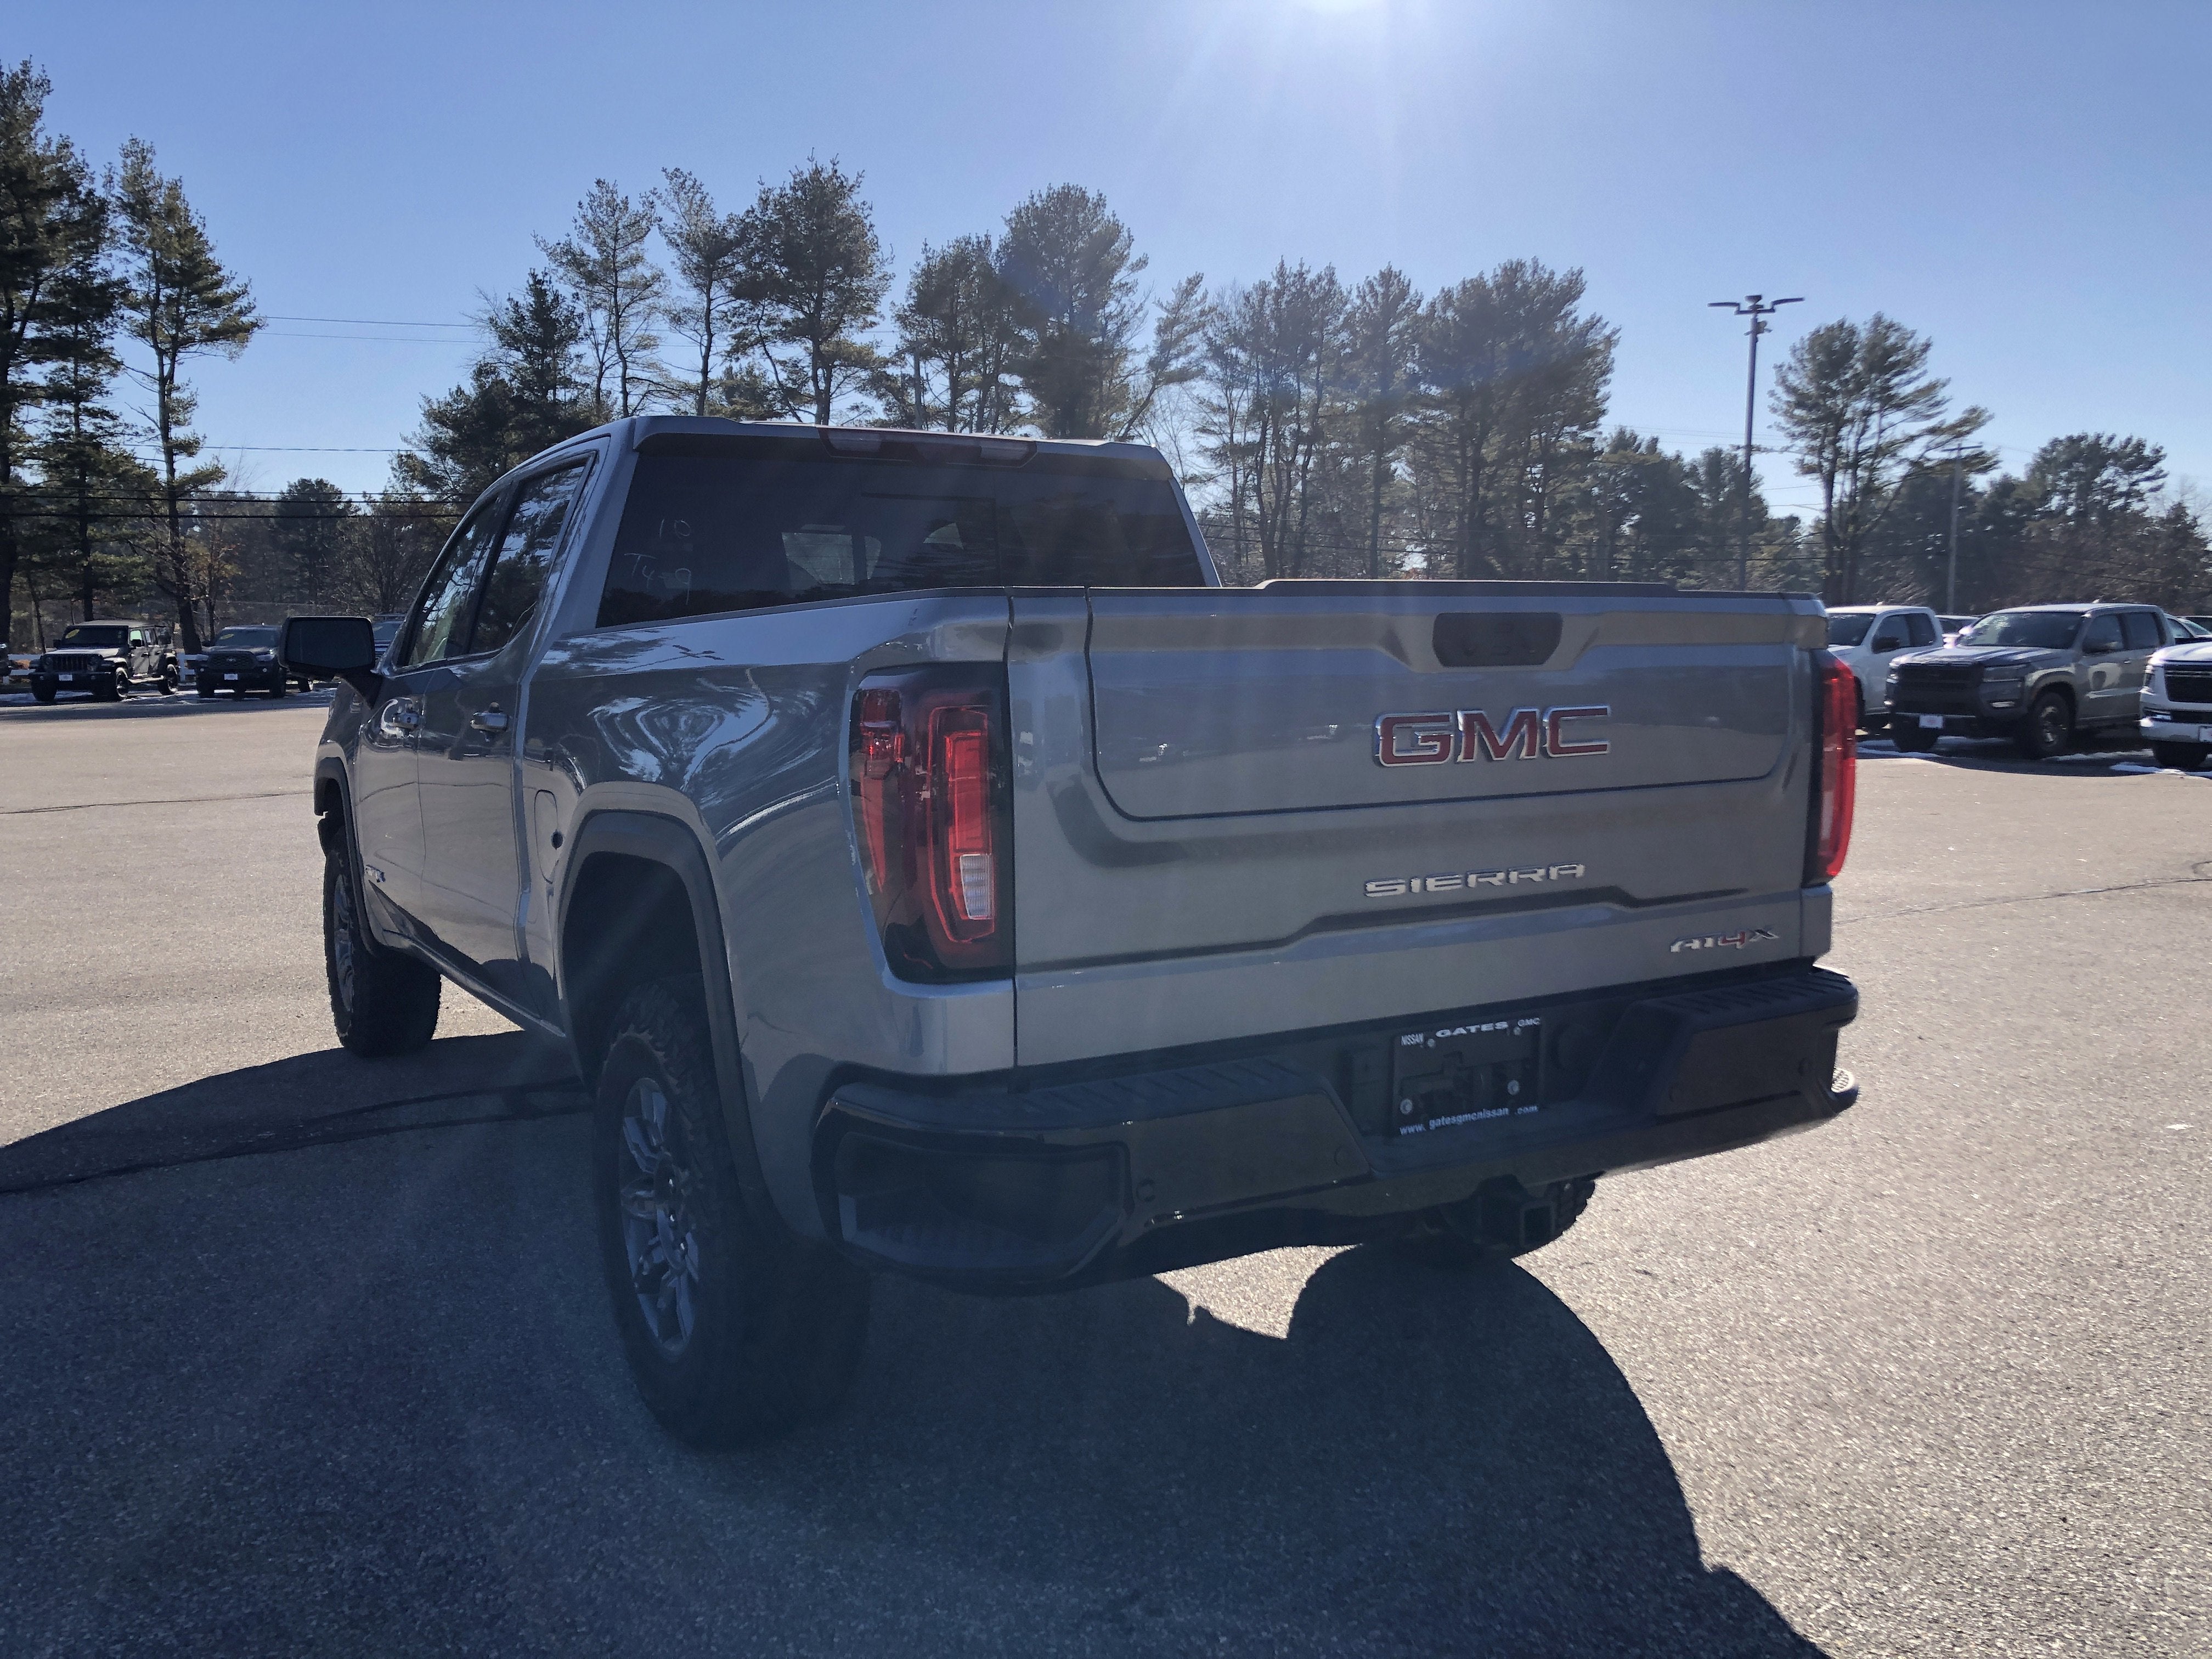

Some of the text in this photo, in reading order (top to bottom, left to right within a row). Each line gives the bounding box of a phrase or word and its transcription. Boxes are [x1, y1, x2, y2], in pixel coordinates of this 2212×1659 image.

[1375, 704, 1612, 767] GMC
[1364, 862, 1586, 898] SIERRA
[1435, 1021, 1509, 1037] GATES
[1517, 1017, 1541, 1027] GMC
